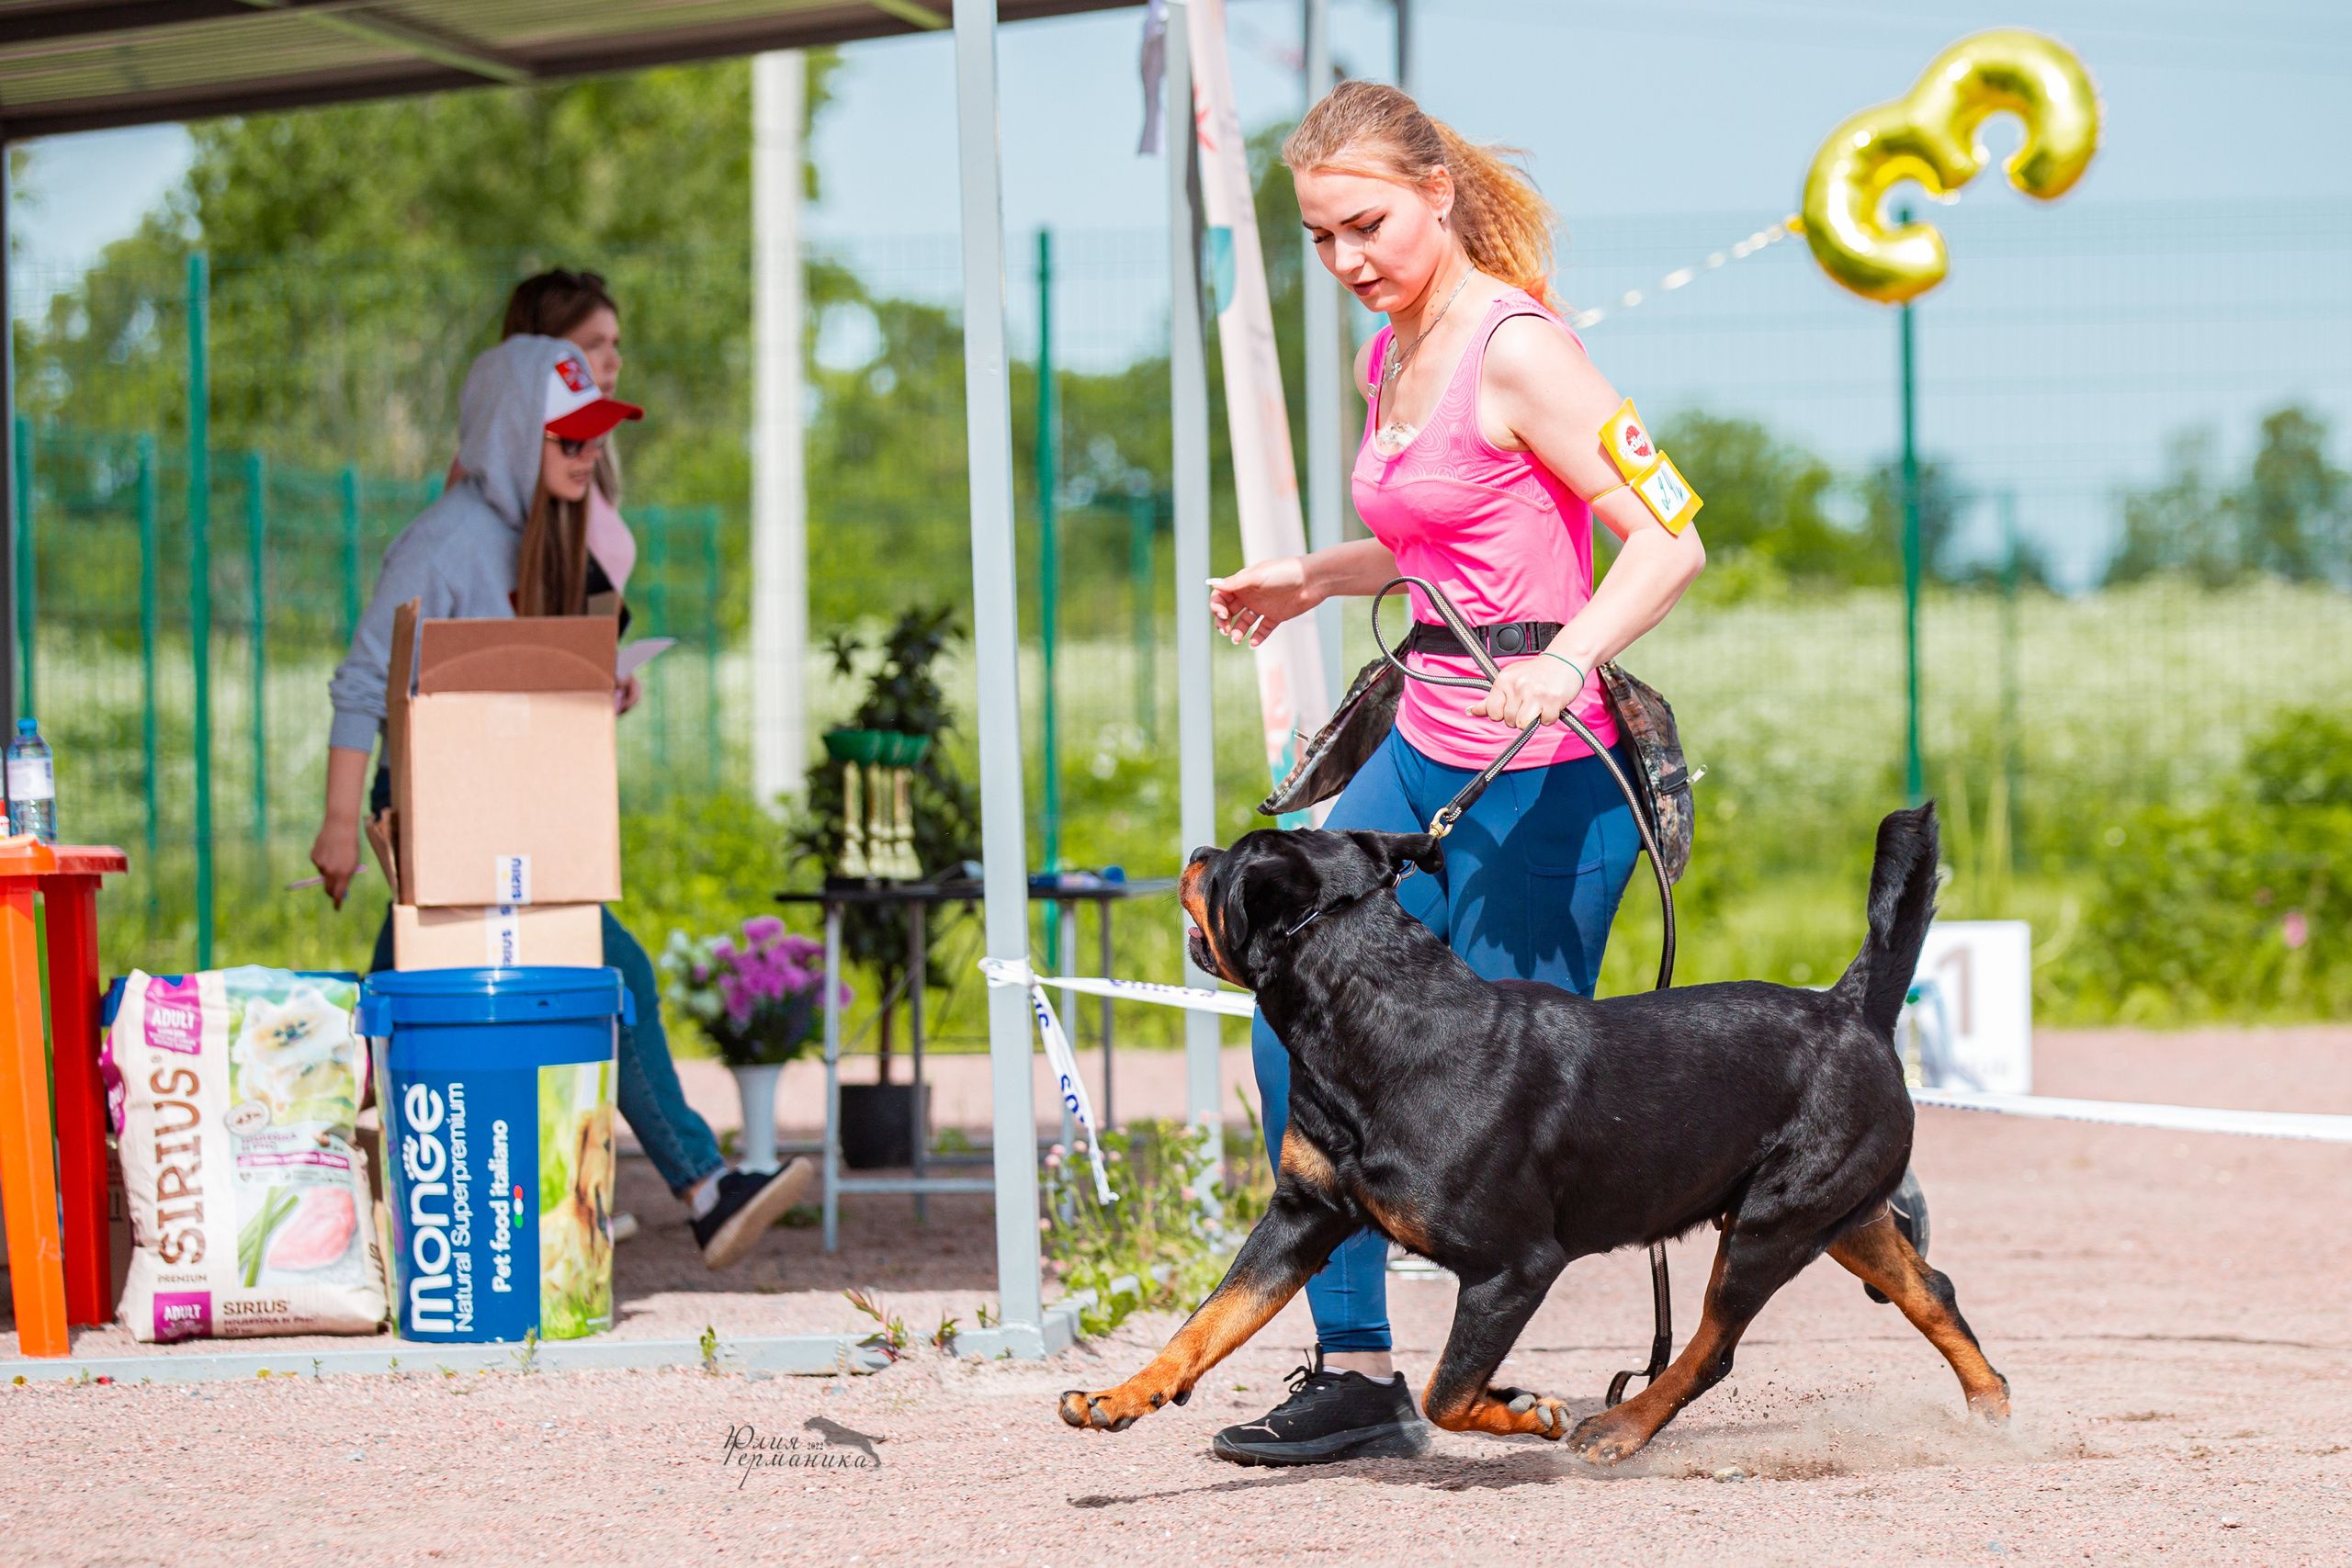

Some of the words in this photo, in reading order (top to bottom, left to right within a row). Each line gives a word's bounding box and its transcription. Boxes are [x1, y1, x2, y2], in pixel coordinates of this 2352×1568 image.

[151, 1008, 196, 1030] ADULT
[1937, 944, 1973, 1035] 1
[150, 1068, 206, 1264] SIRIUS
[447, 1082, 473, 1247] Superpremium
[488, 1119, 509, 1197] italiano
[489, 1200, 511, 1250] food
[455, 1251, 474, 1332] Natural
[492, 1254, 512, 1292] Pet
[163, 1303, 202, 1321] ADULT
[222, 1299, 288, 1316] SIRIUS
